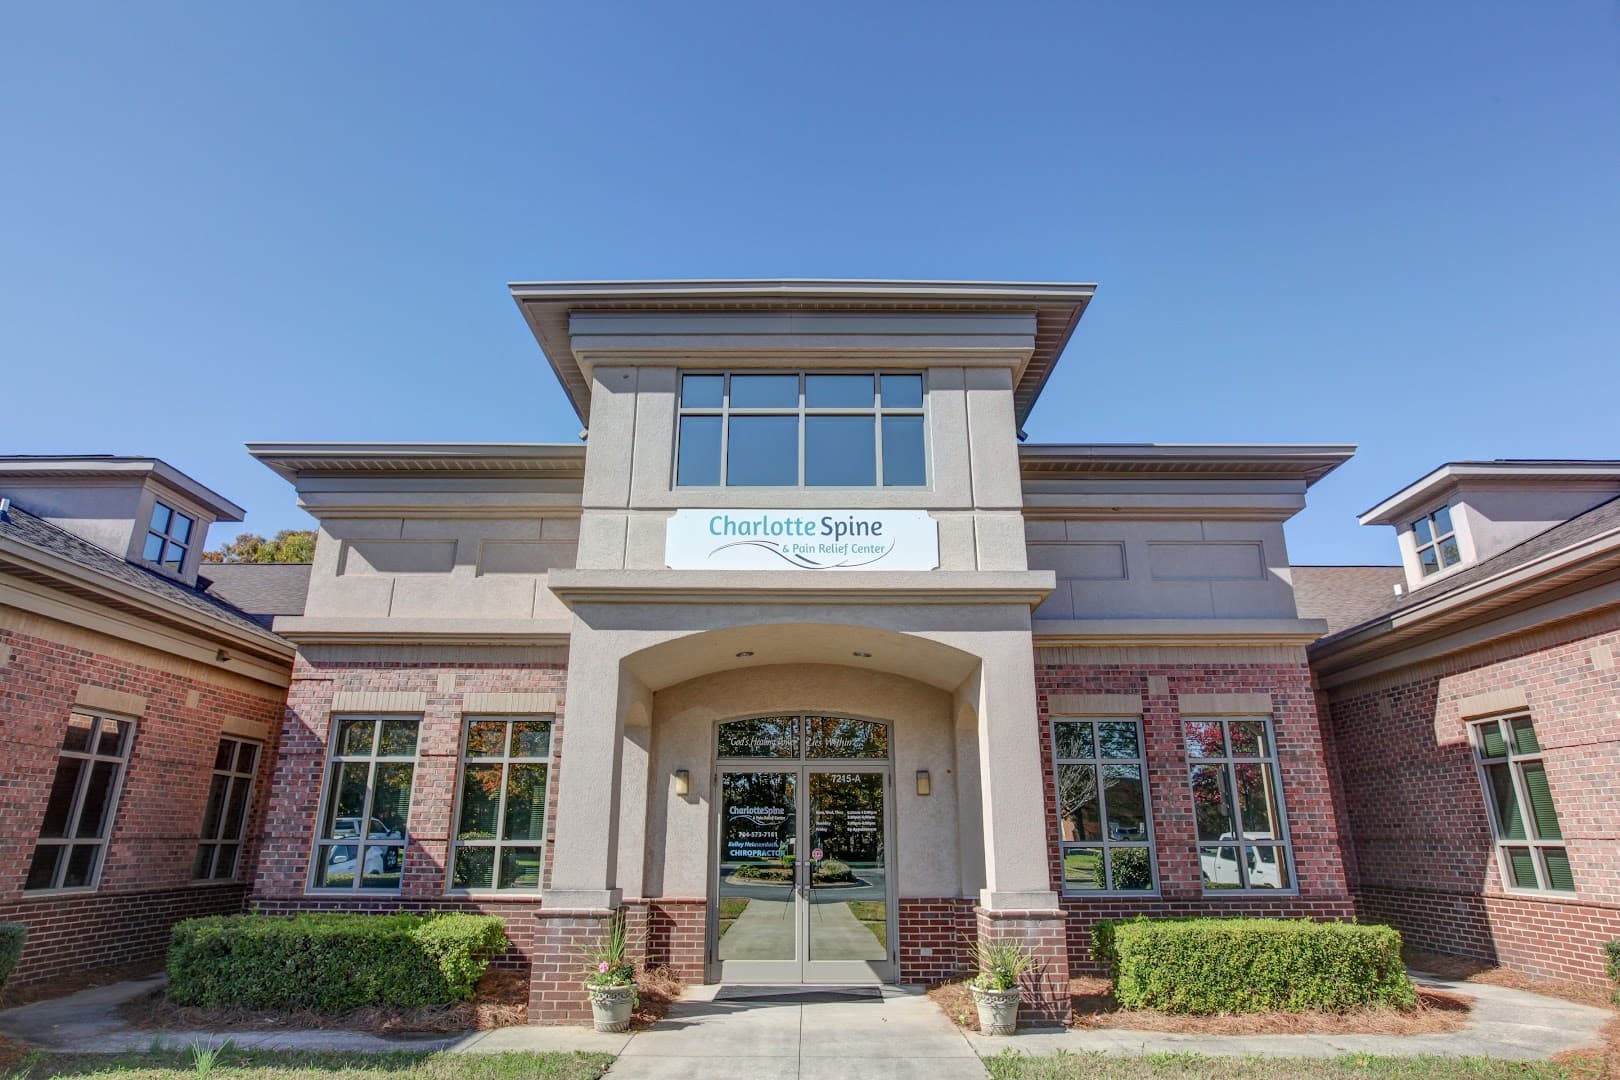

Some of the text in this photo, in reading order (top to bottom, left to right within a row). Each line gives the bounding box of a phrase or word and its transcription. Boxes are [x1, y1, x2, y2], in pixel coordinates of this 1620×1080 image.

[782, 543, 885, 556] & Pain Relief Center
[831, 774, 861, 783] 7215-A
[730, 849, 786, 857] CHIROPRACTOR
